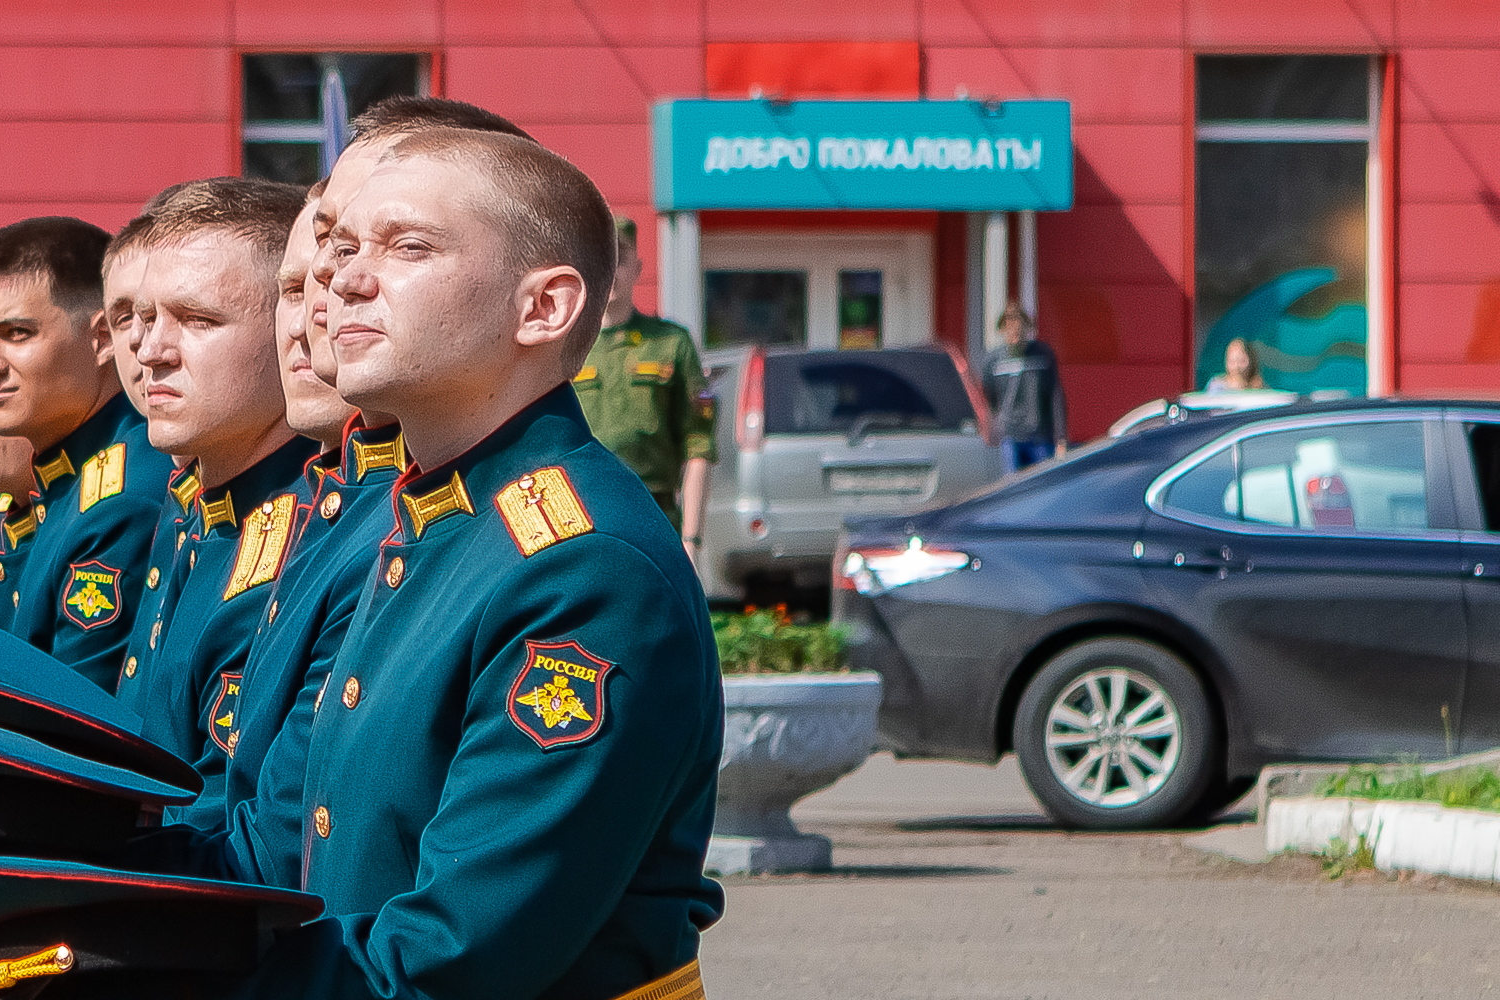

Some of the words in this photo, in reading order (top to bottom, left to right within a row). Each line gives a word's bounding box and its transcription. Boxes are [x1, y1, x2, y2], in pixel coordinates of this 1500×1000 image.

[704, 136, 811, 173] ДОБРО
[818, 136, 1042, 170] ПОЖАЛОВАТЬ!
[75, 570, 114, 584] РОССИЯ
[533, 655, 598, 682] РОССИЯ
